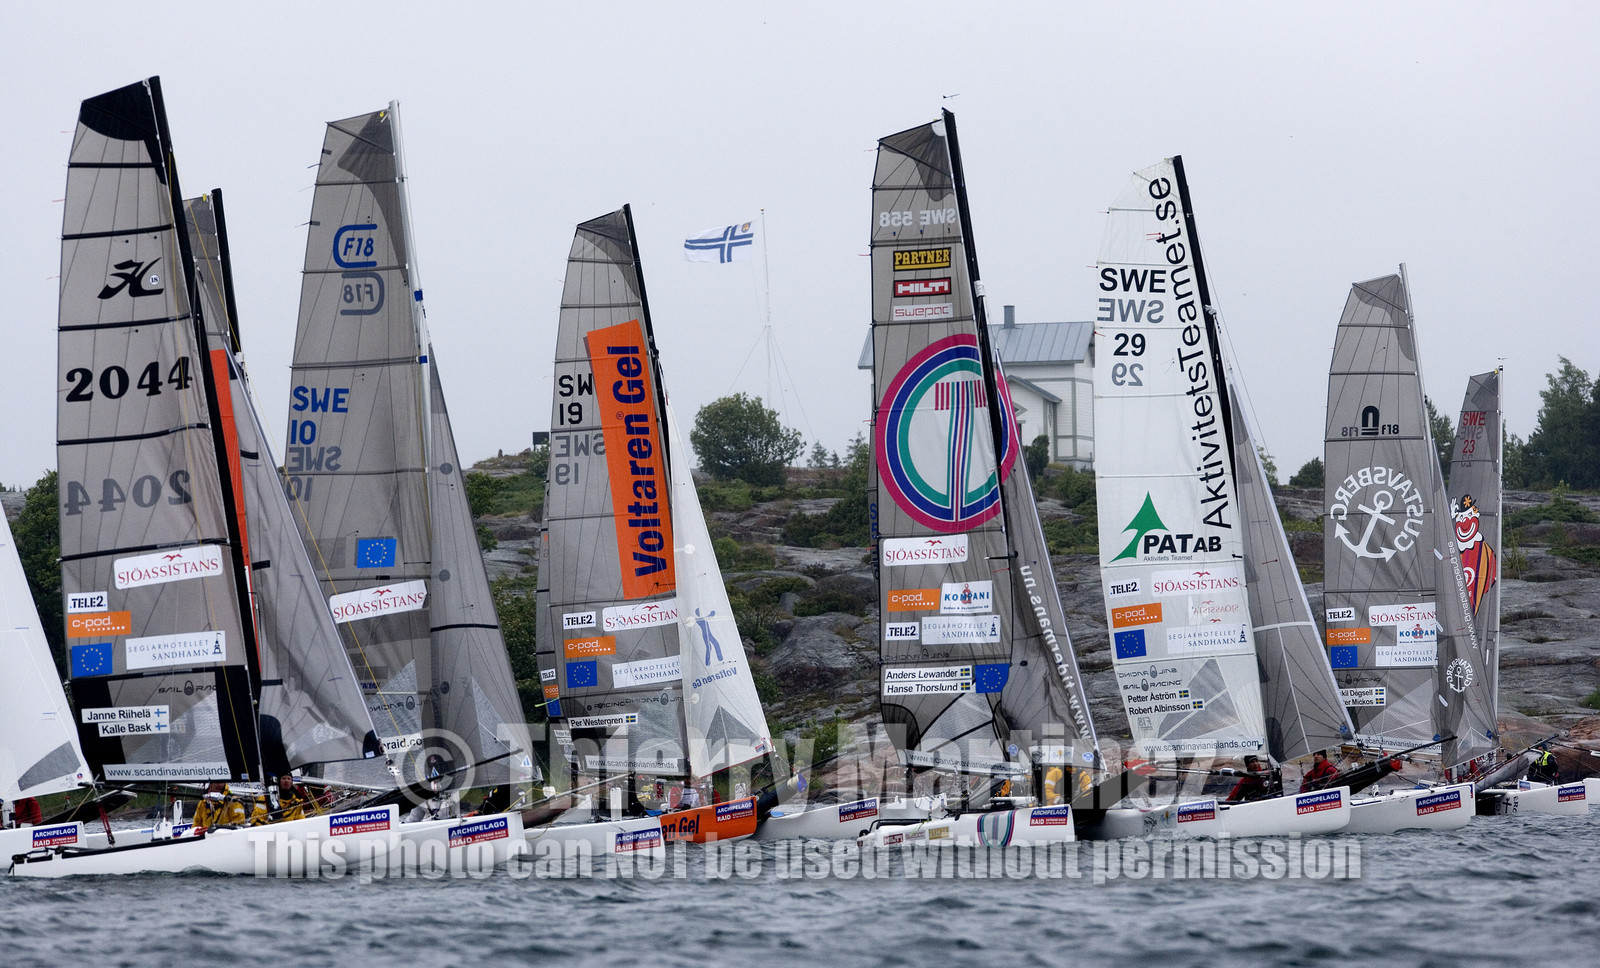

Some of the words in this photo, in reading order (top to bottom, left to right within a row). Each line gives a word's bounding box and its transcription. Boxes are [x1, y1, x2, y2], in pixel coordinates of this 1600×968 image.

[343, 238, 374, 256] F18
[895, 249, 950, 265] PARTNER
[1099, 268, 1167, 293] SWE
[897, 281, 948, 294] HILTI
[1113, 333, 1146, 356] 29
[1149, 177, 1232, 530] AktivitetsTeamet.se
[66, 356, 192, 402] 2044
[607, 346, 646, 404] Gel
[559, 374, 593, 397] SW
[292, 386, 349, 413] SWE
[560, 402, 583, 425] 19
[1463, 412, 1486, 426] SWE
[290, 420, 316, 445] 10
[1462, 439, 1475, 454] 23
[624, 414, 667, 577] Voltaren
[885, 546, 966, 563] SJÖASSISTANS
[117, 558, 219, 584] SJÖASSISTANS
[1154, 577, 1238, 594] SJÖASSISTANS
[944, 592, 989, 602] KOMPANI
[333, 592, 425, 620] SJÖASSISTANS
[924, 622, 987, 630] SEGLARHOTELLET
[1169, 630, 1236, 640] SEGLARHOTELLET
[1399, 629, 1435, 637] KOMPAN
[128, 640, 209, 653] SEGLARHOTELLET
[1188, 638, 1236, 647] SANDHAMN
[152, 649, 209, 661] SANDHAMN
[614, 661, 680, 675] SEGLARHOTELLET
[886, 670, 916, 680] Anders
[918, 668, 958, 679] Lewander
[634, 669, 680, 681] SANDHAMN
[887, 685, 913, 693] Hanse
[916, 682, 958, 692] Thorslund
[1150, 680, 1181, 688] RACING
[1127, 695, 1148, 703] Petter
[87, 711, 116, 721] Janne
[119, 708, 151, 719] Riihelä
[1129, 706, 1152, 715] Robert
[1154, 703, 1190, 713] Albinsson
[571, 719, 582, 727] Per
[584, 716, 623, 727] Westergren
[102, 724, 126, 735] Kalle
[128, 722, 152, 733] Bask
[1143, 739, 1259, 752] www.scandinavianislands.com
[1298, 793, 1339, 805] ARCHIPELAGO
[1418, 793, 1459, 806] ARCHIPELAGO
[717, 802, 752, 813] ARCHIPELAGO
[841, 802, 876, 813] ARCHIPELAGO
[1179, 803, 1213, 812] ARCHIPELAGO
[1298, 806, 1314, 814] RAID
[332, 813, 387, 825] ARCHIPELAGO
[332, 826, 353, 835] RAID
[451, 821, 505, 836] ARCHIPELAGO
[679, 814, 700, 838] Gel
[35, 828, 75, 838] ARCHIPELAGO
[617, 831, 659, 842] ARCHIPELAGO
[451, 837, 472, 847] RAID
